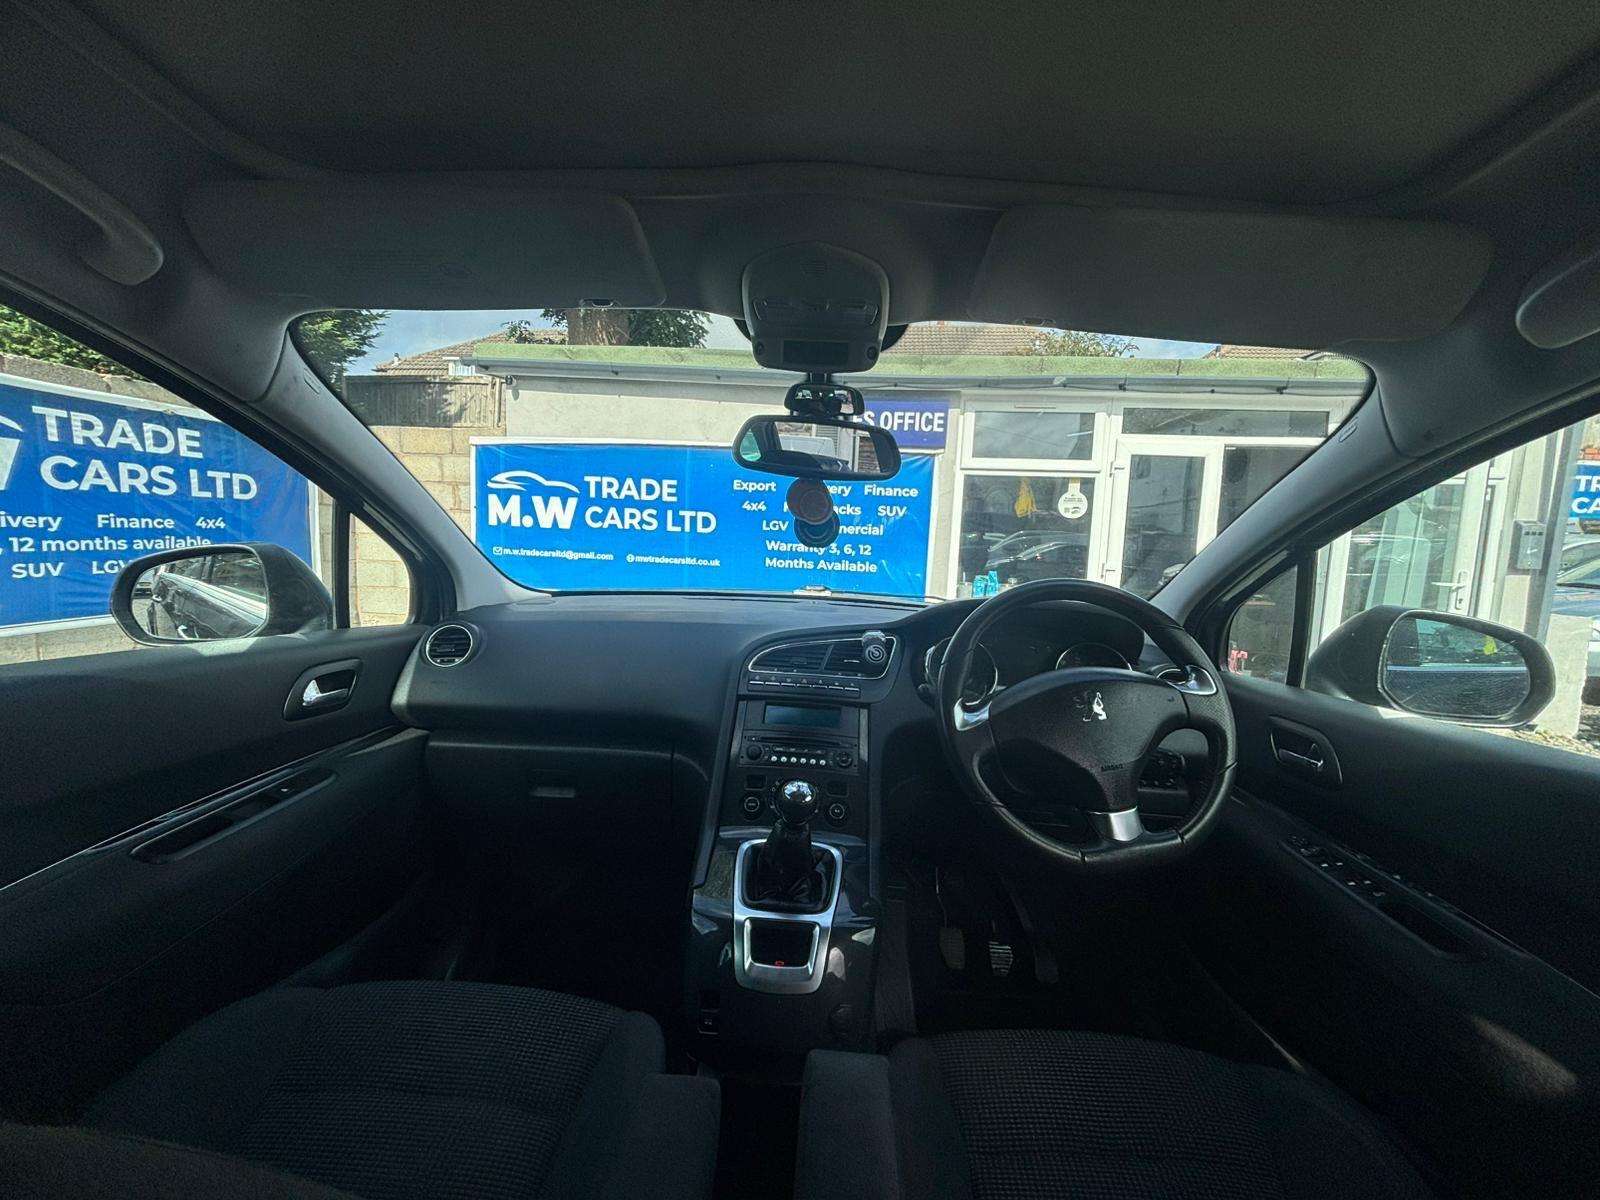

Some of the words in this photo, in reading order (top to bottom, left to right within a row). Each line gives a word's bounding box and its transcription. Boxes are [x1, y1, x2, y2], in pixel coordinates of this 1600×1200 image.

[880, 411, 945, 432] OFFICE
[32, 405, 204, 459] TRADE
[40, 455, 178, 496] CARS
[189, 468, 258, 500] LTD
[583, 476, 678, 502] TRADE
[733, 479, 777, 492] Export
[864, 484, 919, 497] Finance
[487, 494, 578, 530] M.W
[742, 501, 767, 512] 4x4
[877, 505, 907, 517] SUV
[97, 513, 175, 529] Finance
[195, 517, 226, 529] 4x4
[585, 506, 659, 531] CARS
[666, 509, 717, 534] LTD
[762, 520, 789, 531] LGV
[8, 536, 36, 552] 12
[41, 536, 128, 552] months
[843, 544, 856, 557] 6,
[858, 544, 872, 556] 12
[11, 562, 65, 579] SUV
[765, 557, 814, 571] Months
[816, 559, 878, 573] Available
